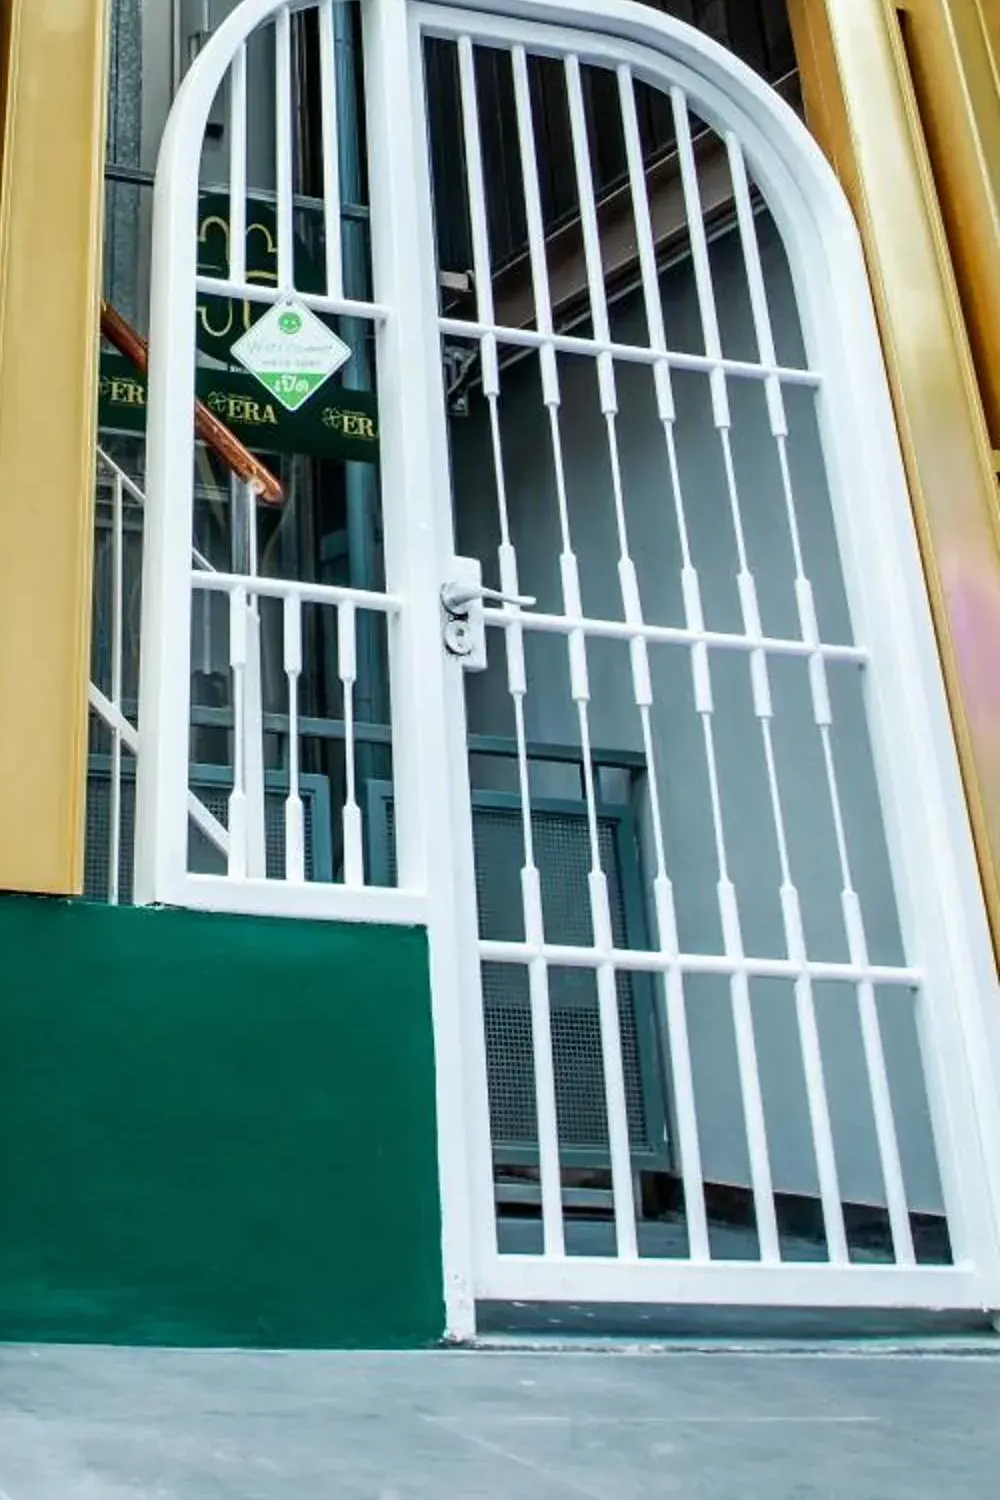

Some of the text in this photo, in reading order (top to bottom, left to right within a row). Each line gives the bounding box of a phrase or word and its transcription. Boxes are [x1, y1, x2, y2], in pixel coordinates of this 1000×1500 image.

[109, 381, 146, 405] ER
[227, 398, 279, 425] ERA
[342, 415, 378, 438] ER
